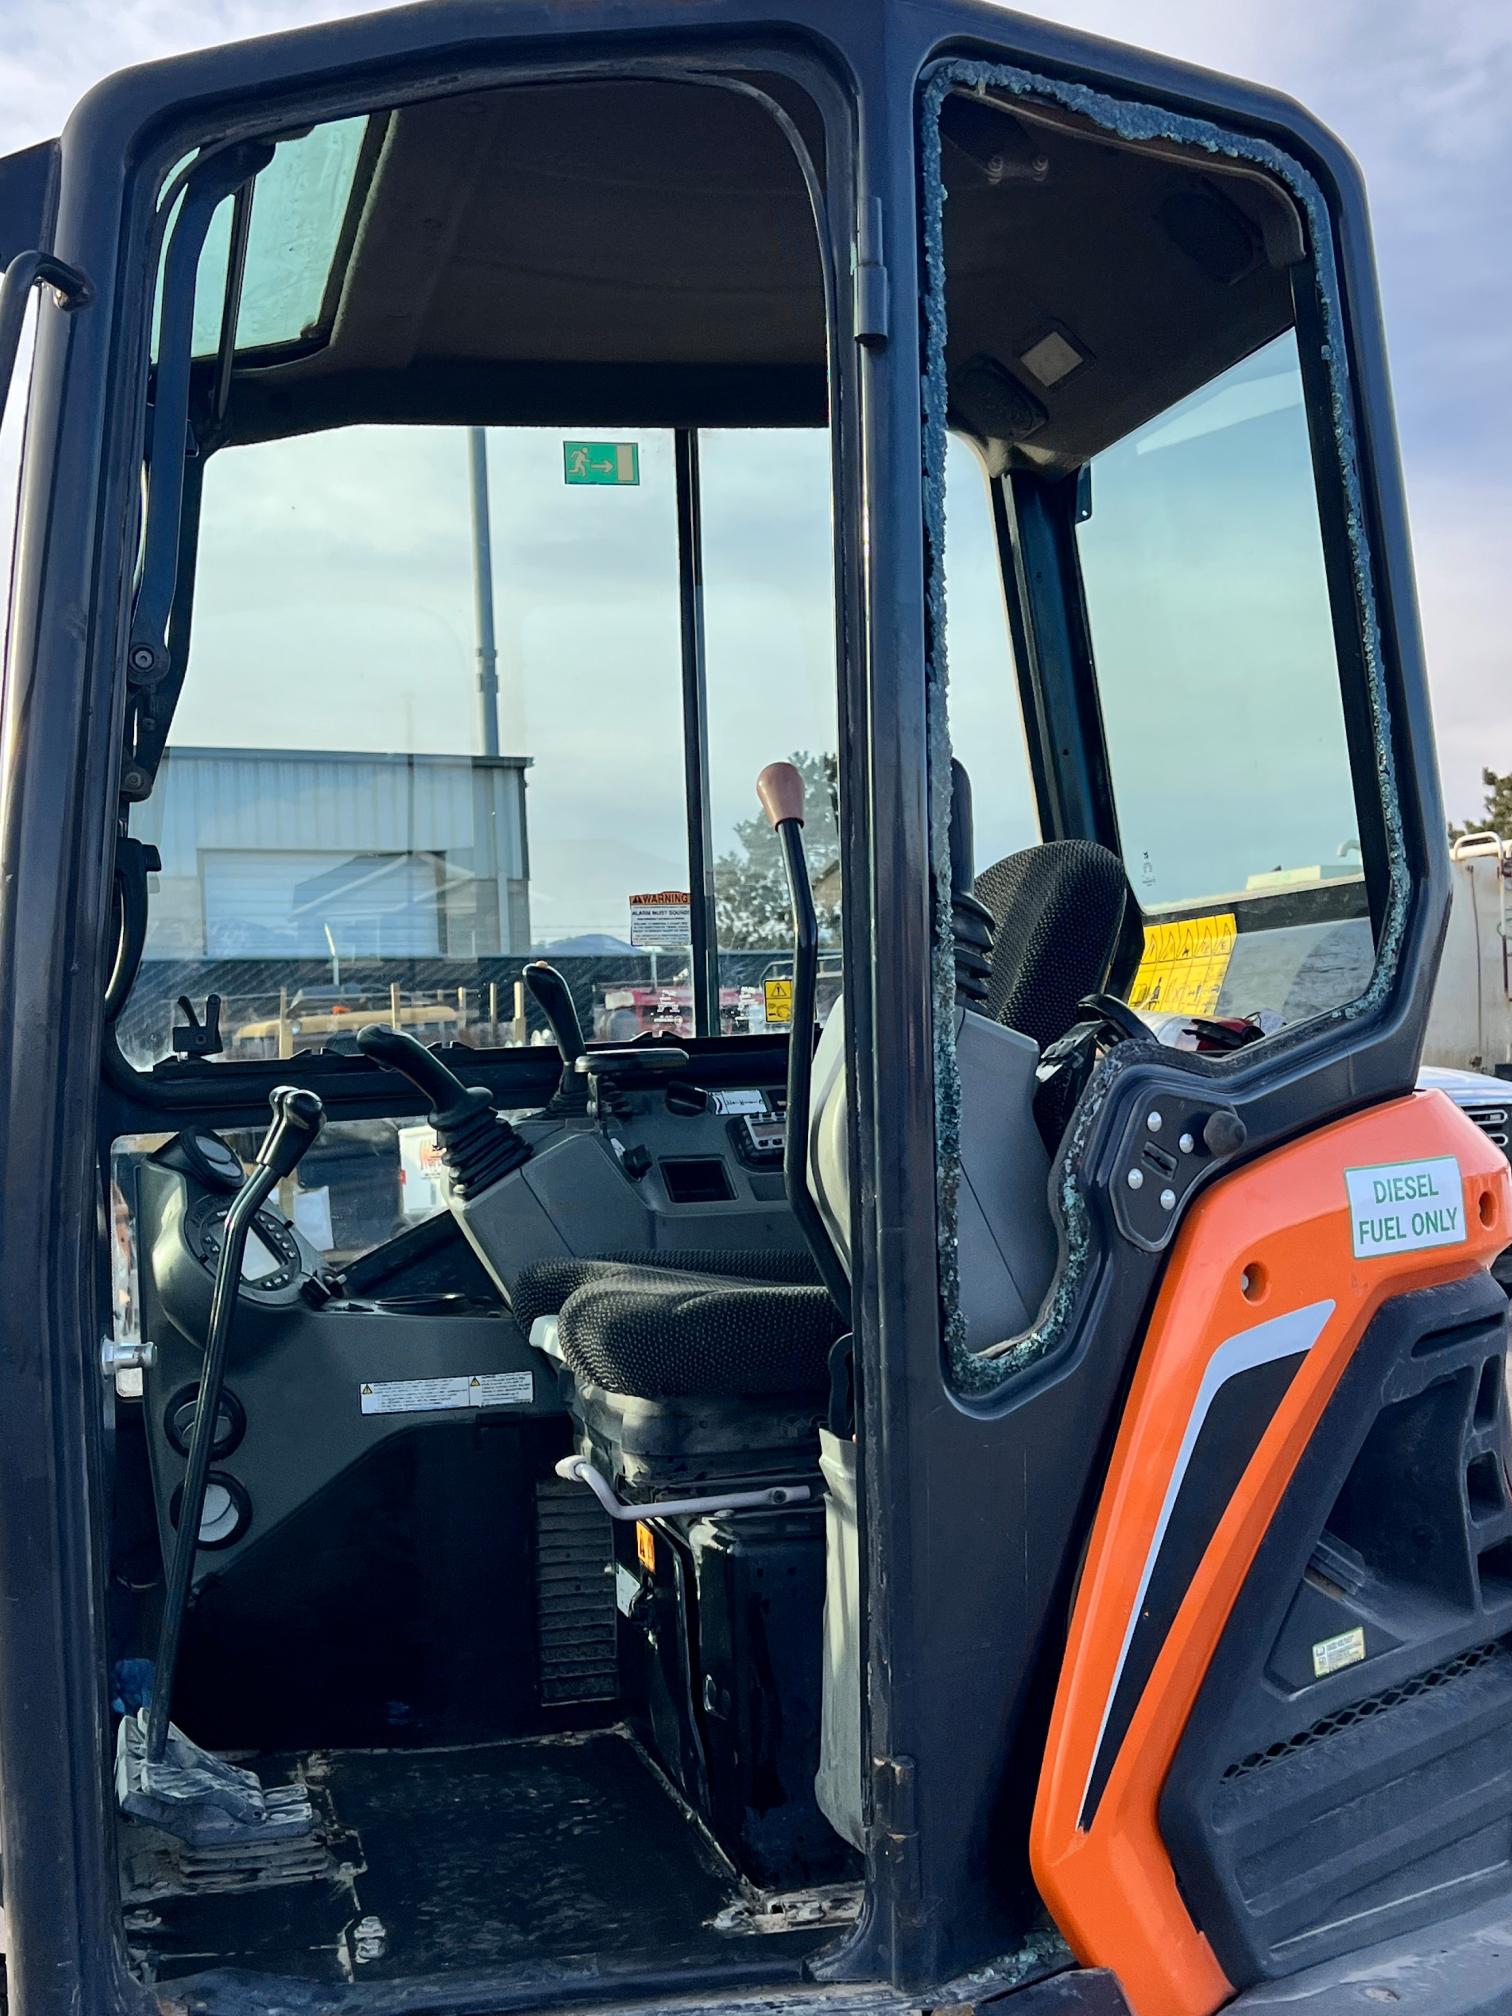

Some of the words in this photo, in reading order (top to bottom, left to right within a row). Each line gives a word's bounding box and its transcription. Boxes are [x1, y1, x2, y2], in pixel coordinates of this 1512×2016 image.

[642, 893, 688, 903] WARNING
[1373, 1173, 1439, 1204] DIESEL
[1359, 1216, 1407, 1244] FUEL
[1411, 1207, 1457, 1236] ONLY
